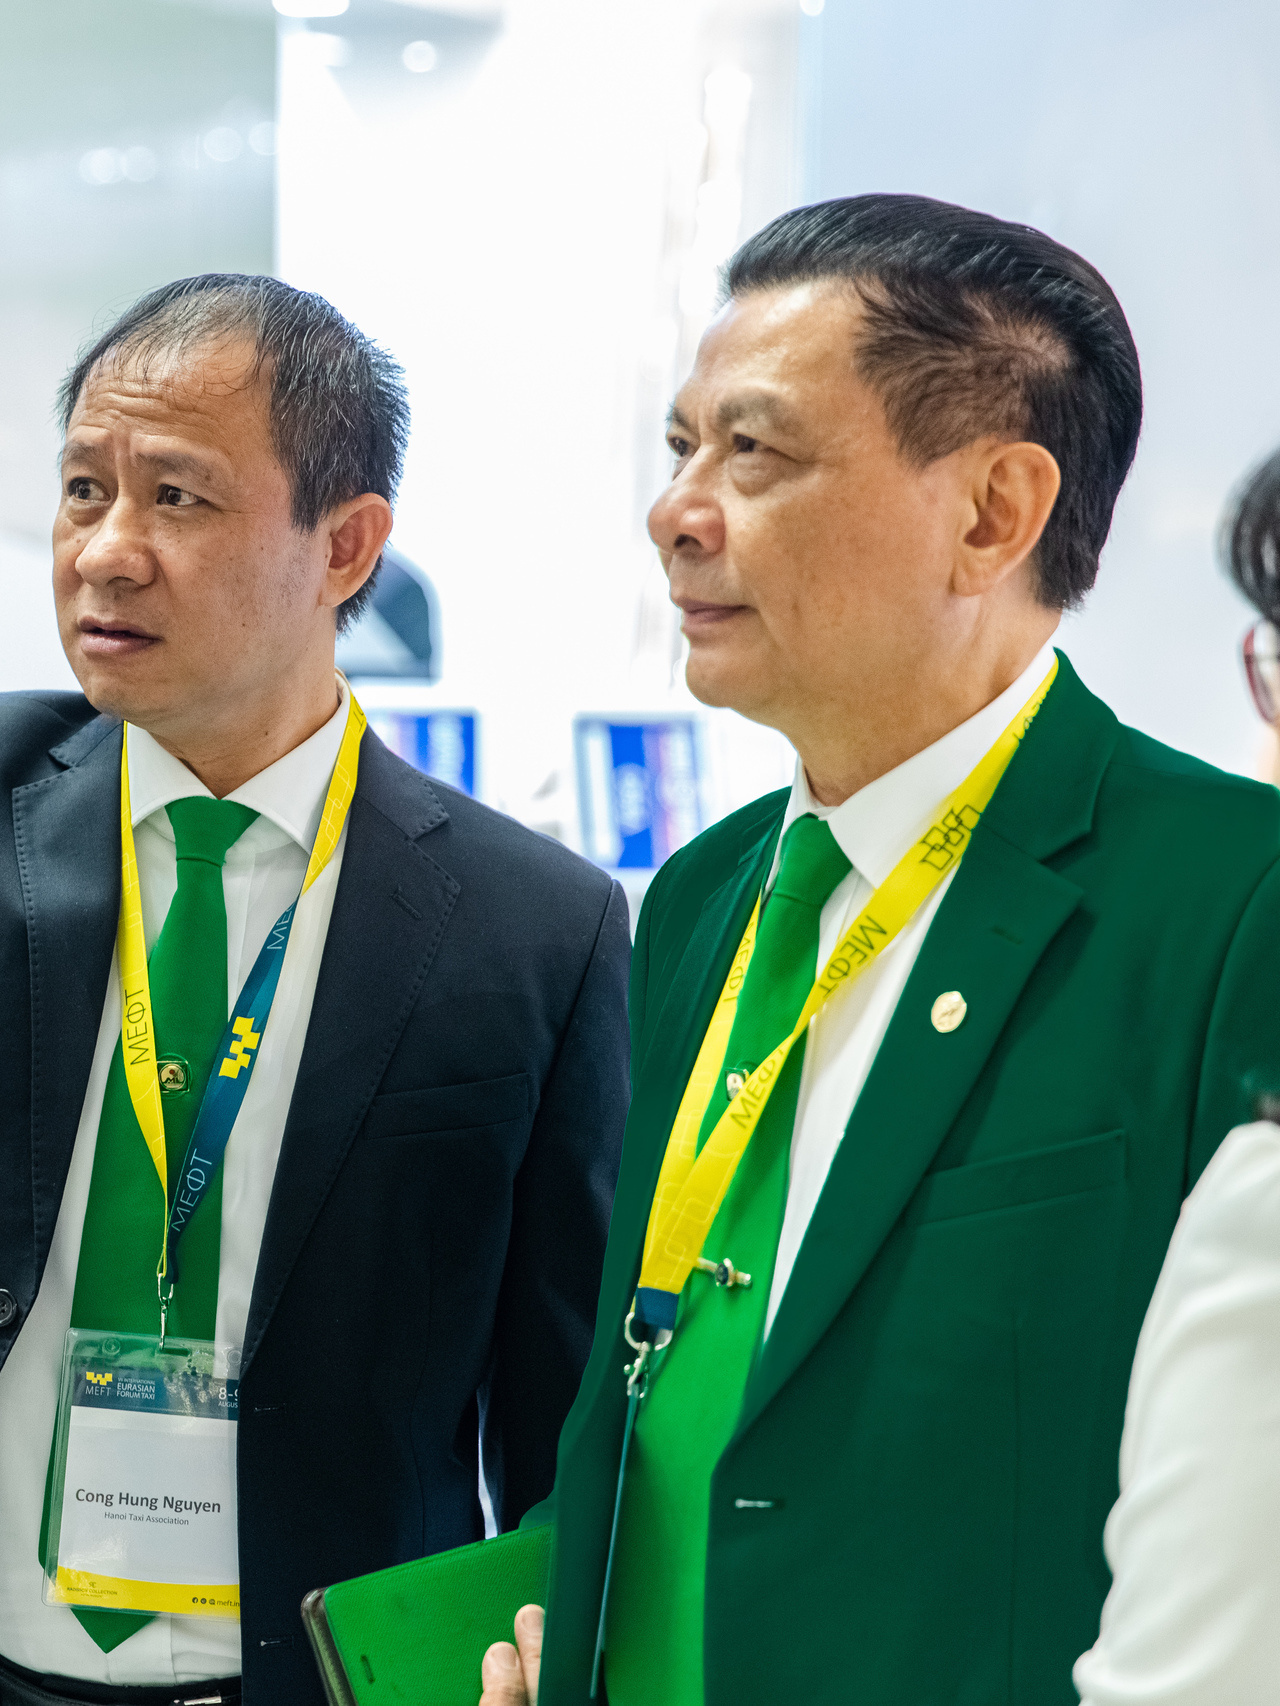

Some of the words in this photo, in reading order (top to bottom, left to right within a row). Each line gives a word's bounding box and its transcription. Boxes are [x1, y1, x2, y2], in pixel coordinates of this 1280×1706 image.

[267, 902, 295, 950] МЕ
[818, 914, 888, 999] МЕФТ
[124, 988, 150, 1066] МЕФТ
[171, 1147, 213, 1232] МЕФТ
[85, 1385, 112, 1397] MEFT
[116, 1390, 141, 1399] FORUM
[141, 1392, 156, 1400] TAXI
[117, 1382, 156, 1394] EURASIAN
[217, 1400, 239, 1409] AUGUS
[75, 1488, 114, 1507] Cong
[118, 1491, 159, 1511] Hung
[163, 1495, 221, 1515] Nguyen
[104, 1511, 127, 1520] Hanoi
[128, 1513, 144, 1522] Taxi
[145, 1515, 189, 1526] Association
